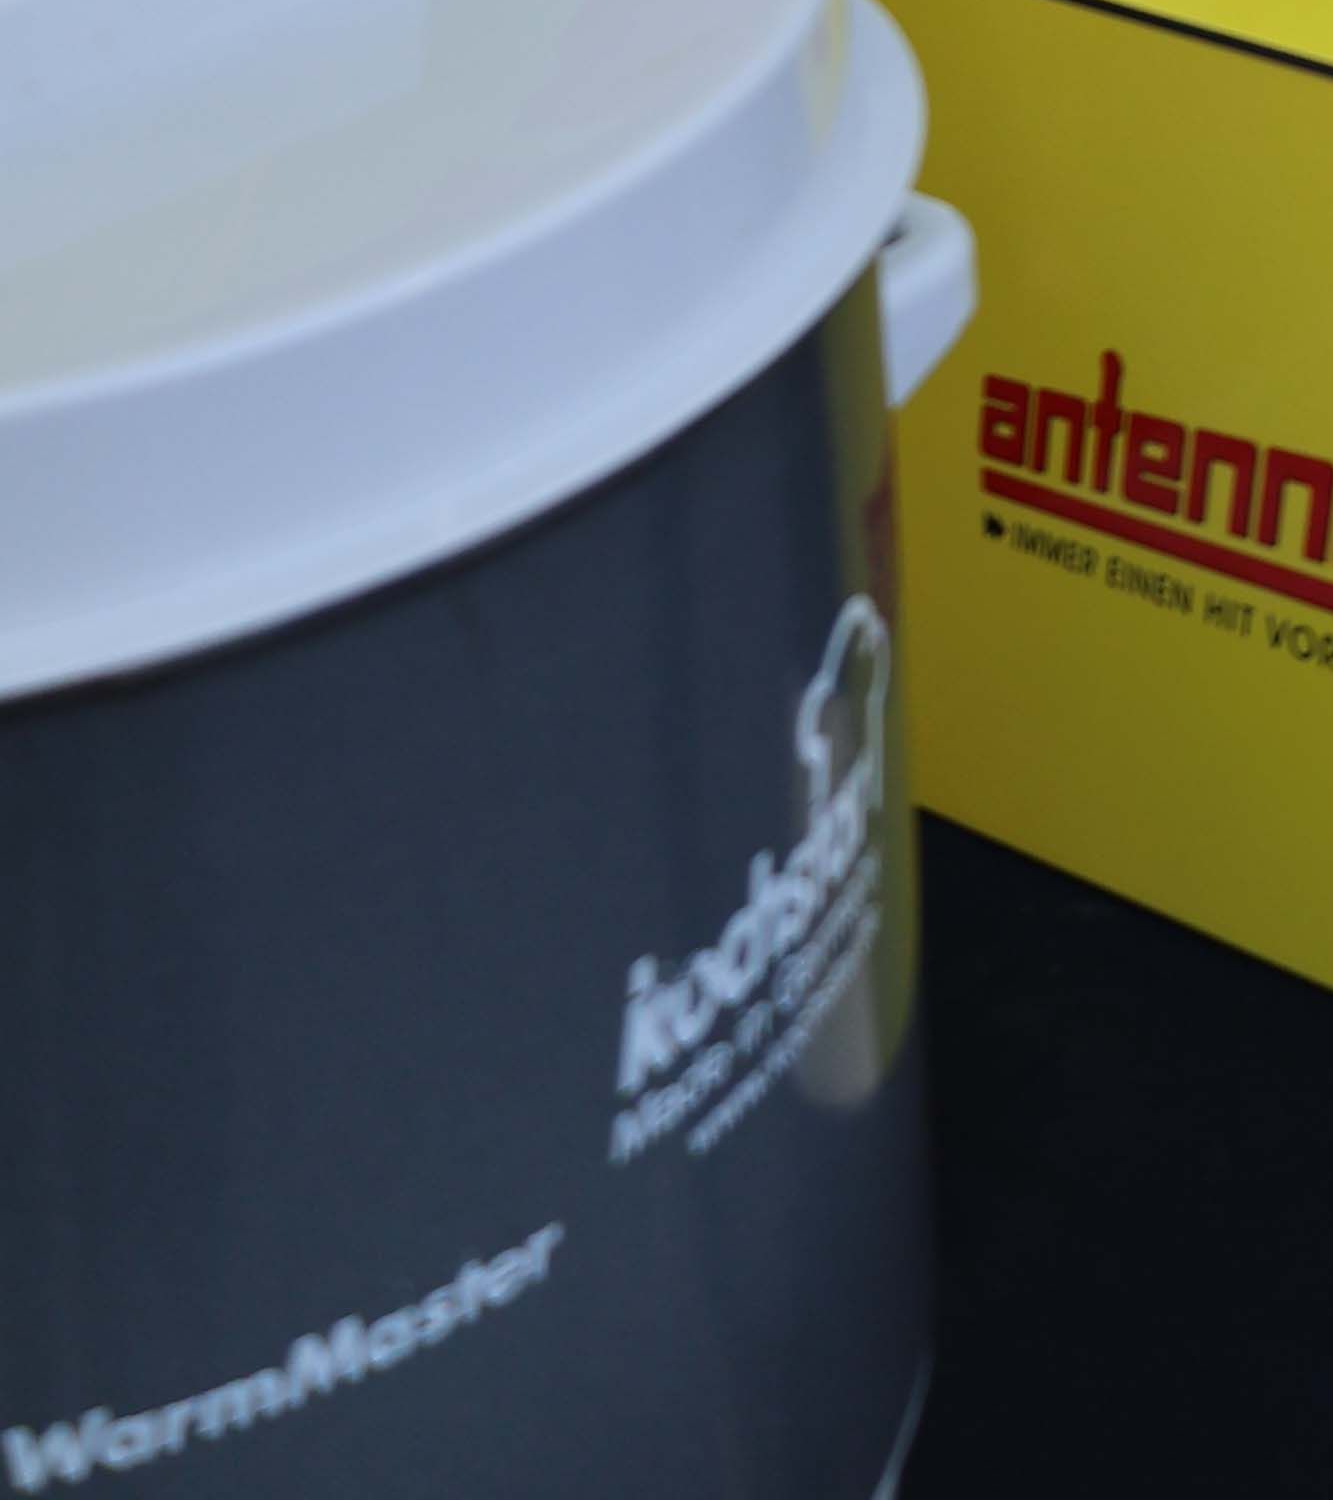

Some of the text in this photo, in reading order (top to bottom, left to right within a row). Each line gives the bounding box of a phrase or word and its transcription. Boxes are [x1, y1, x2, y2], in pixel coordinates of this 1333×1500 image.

[1009, 519, 1099, 577] IMMER
[1106, 554, 1196, 615] EINEN
[1202, 591, 1256, 637] HIT
[2, 1220, 564, 1495] WarmMaster
